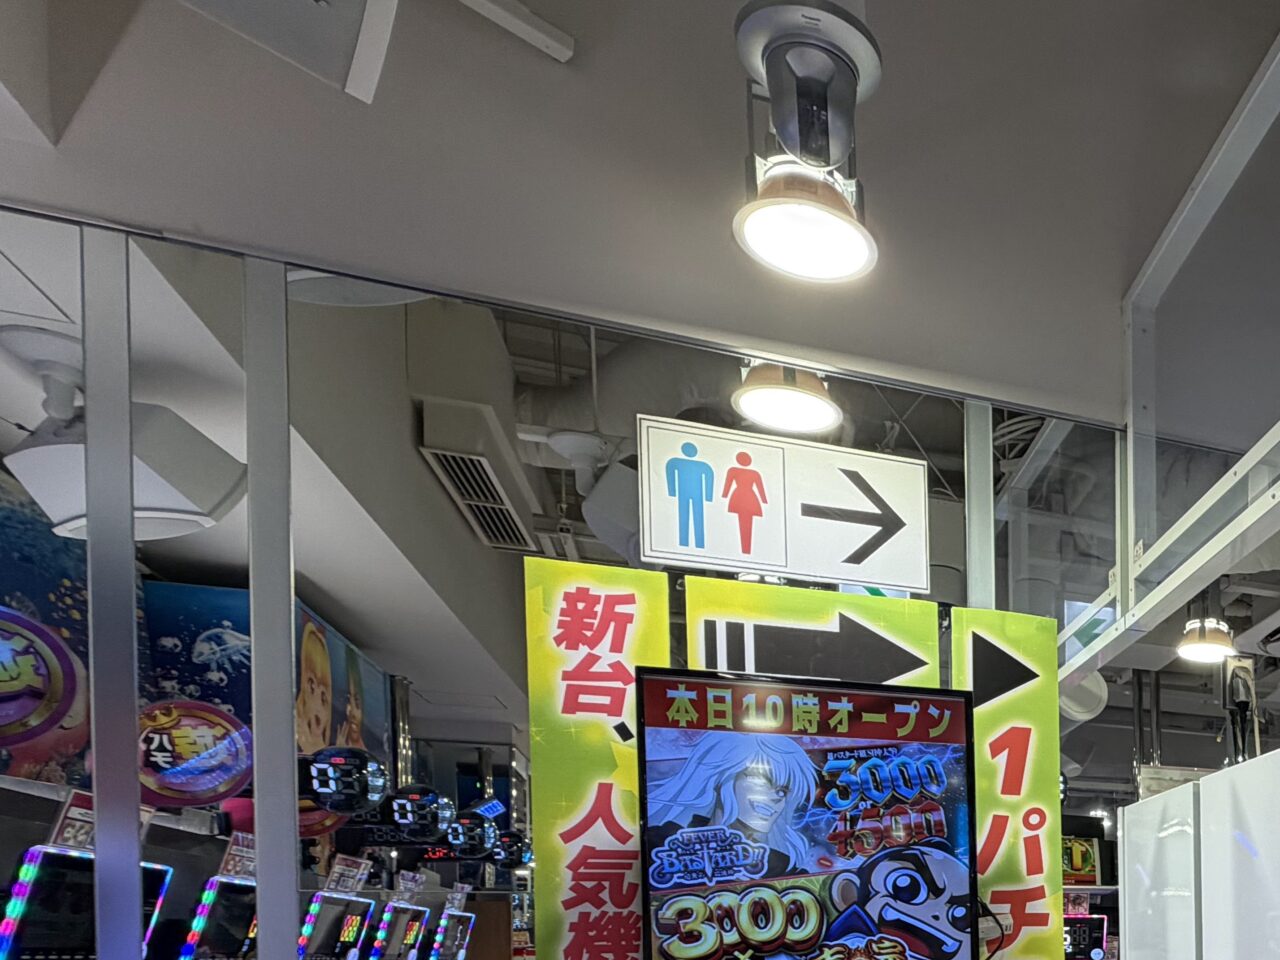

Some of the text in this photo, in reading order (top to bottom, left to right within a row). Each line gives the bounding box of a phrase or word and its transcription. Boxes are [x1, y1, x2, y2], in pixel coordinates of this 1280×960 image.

[666, 684, 951, 738] 本日10時オープン
[823, 755, 947, 811] 3000
